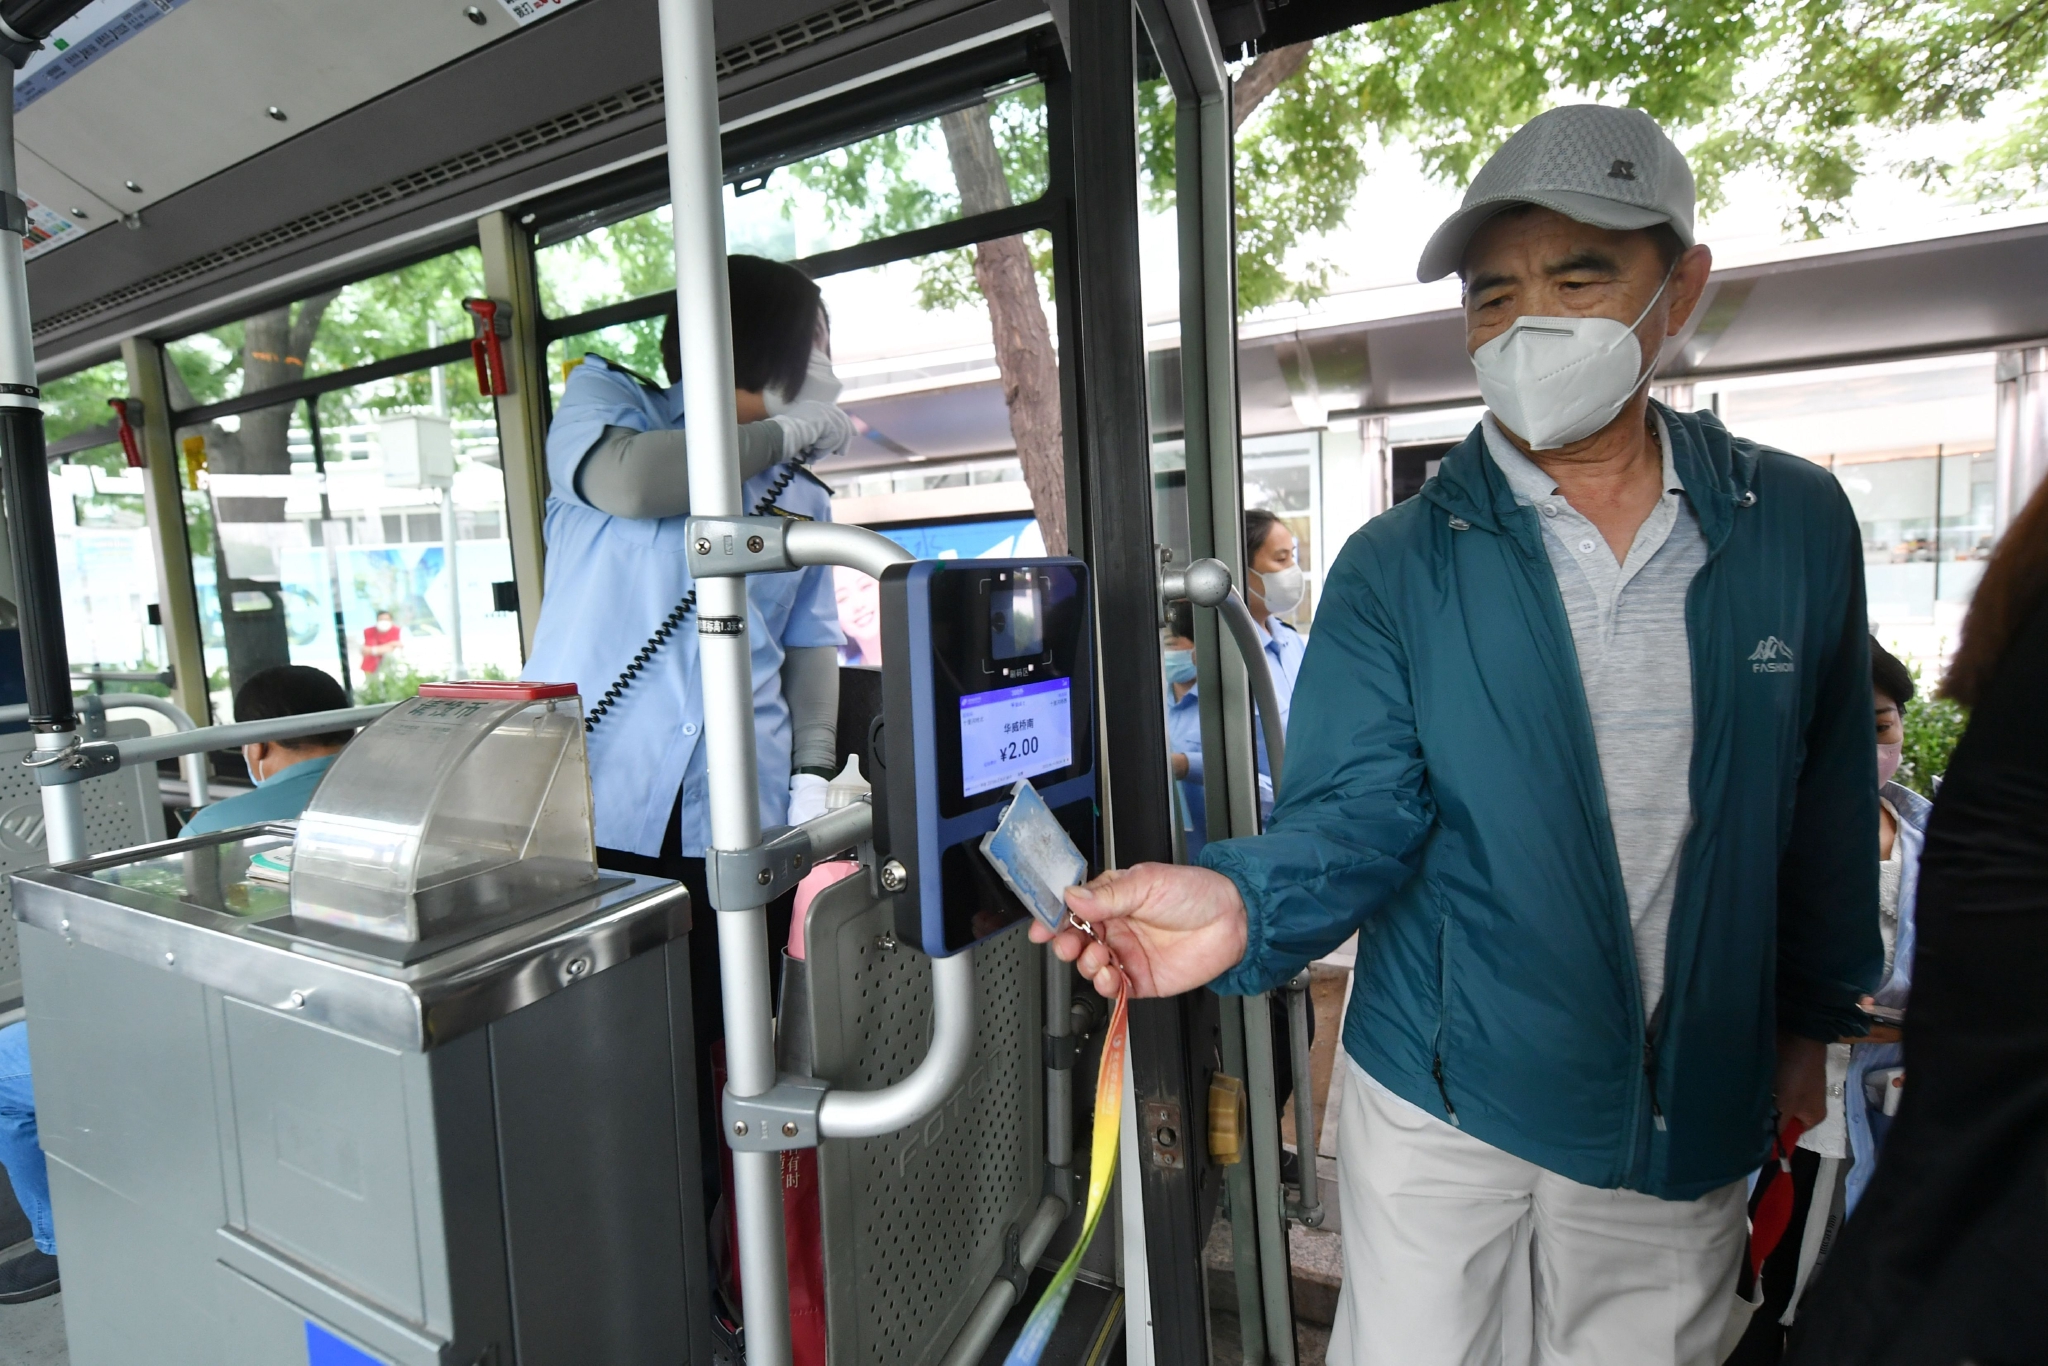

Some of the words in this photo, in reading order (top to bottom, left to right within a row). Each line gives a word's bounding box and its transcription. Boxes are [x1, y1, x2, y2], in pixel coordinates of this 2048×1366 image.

[407, 701, 489, 718] 请投币
[1004, 718, 1034, 734] 华威桥南
[1000, 737, 1038, 761] ¥2.00
